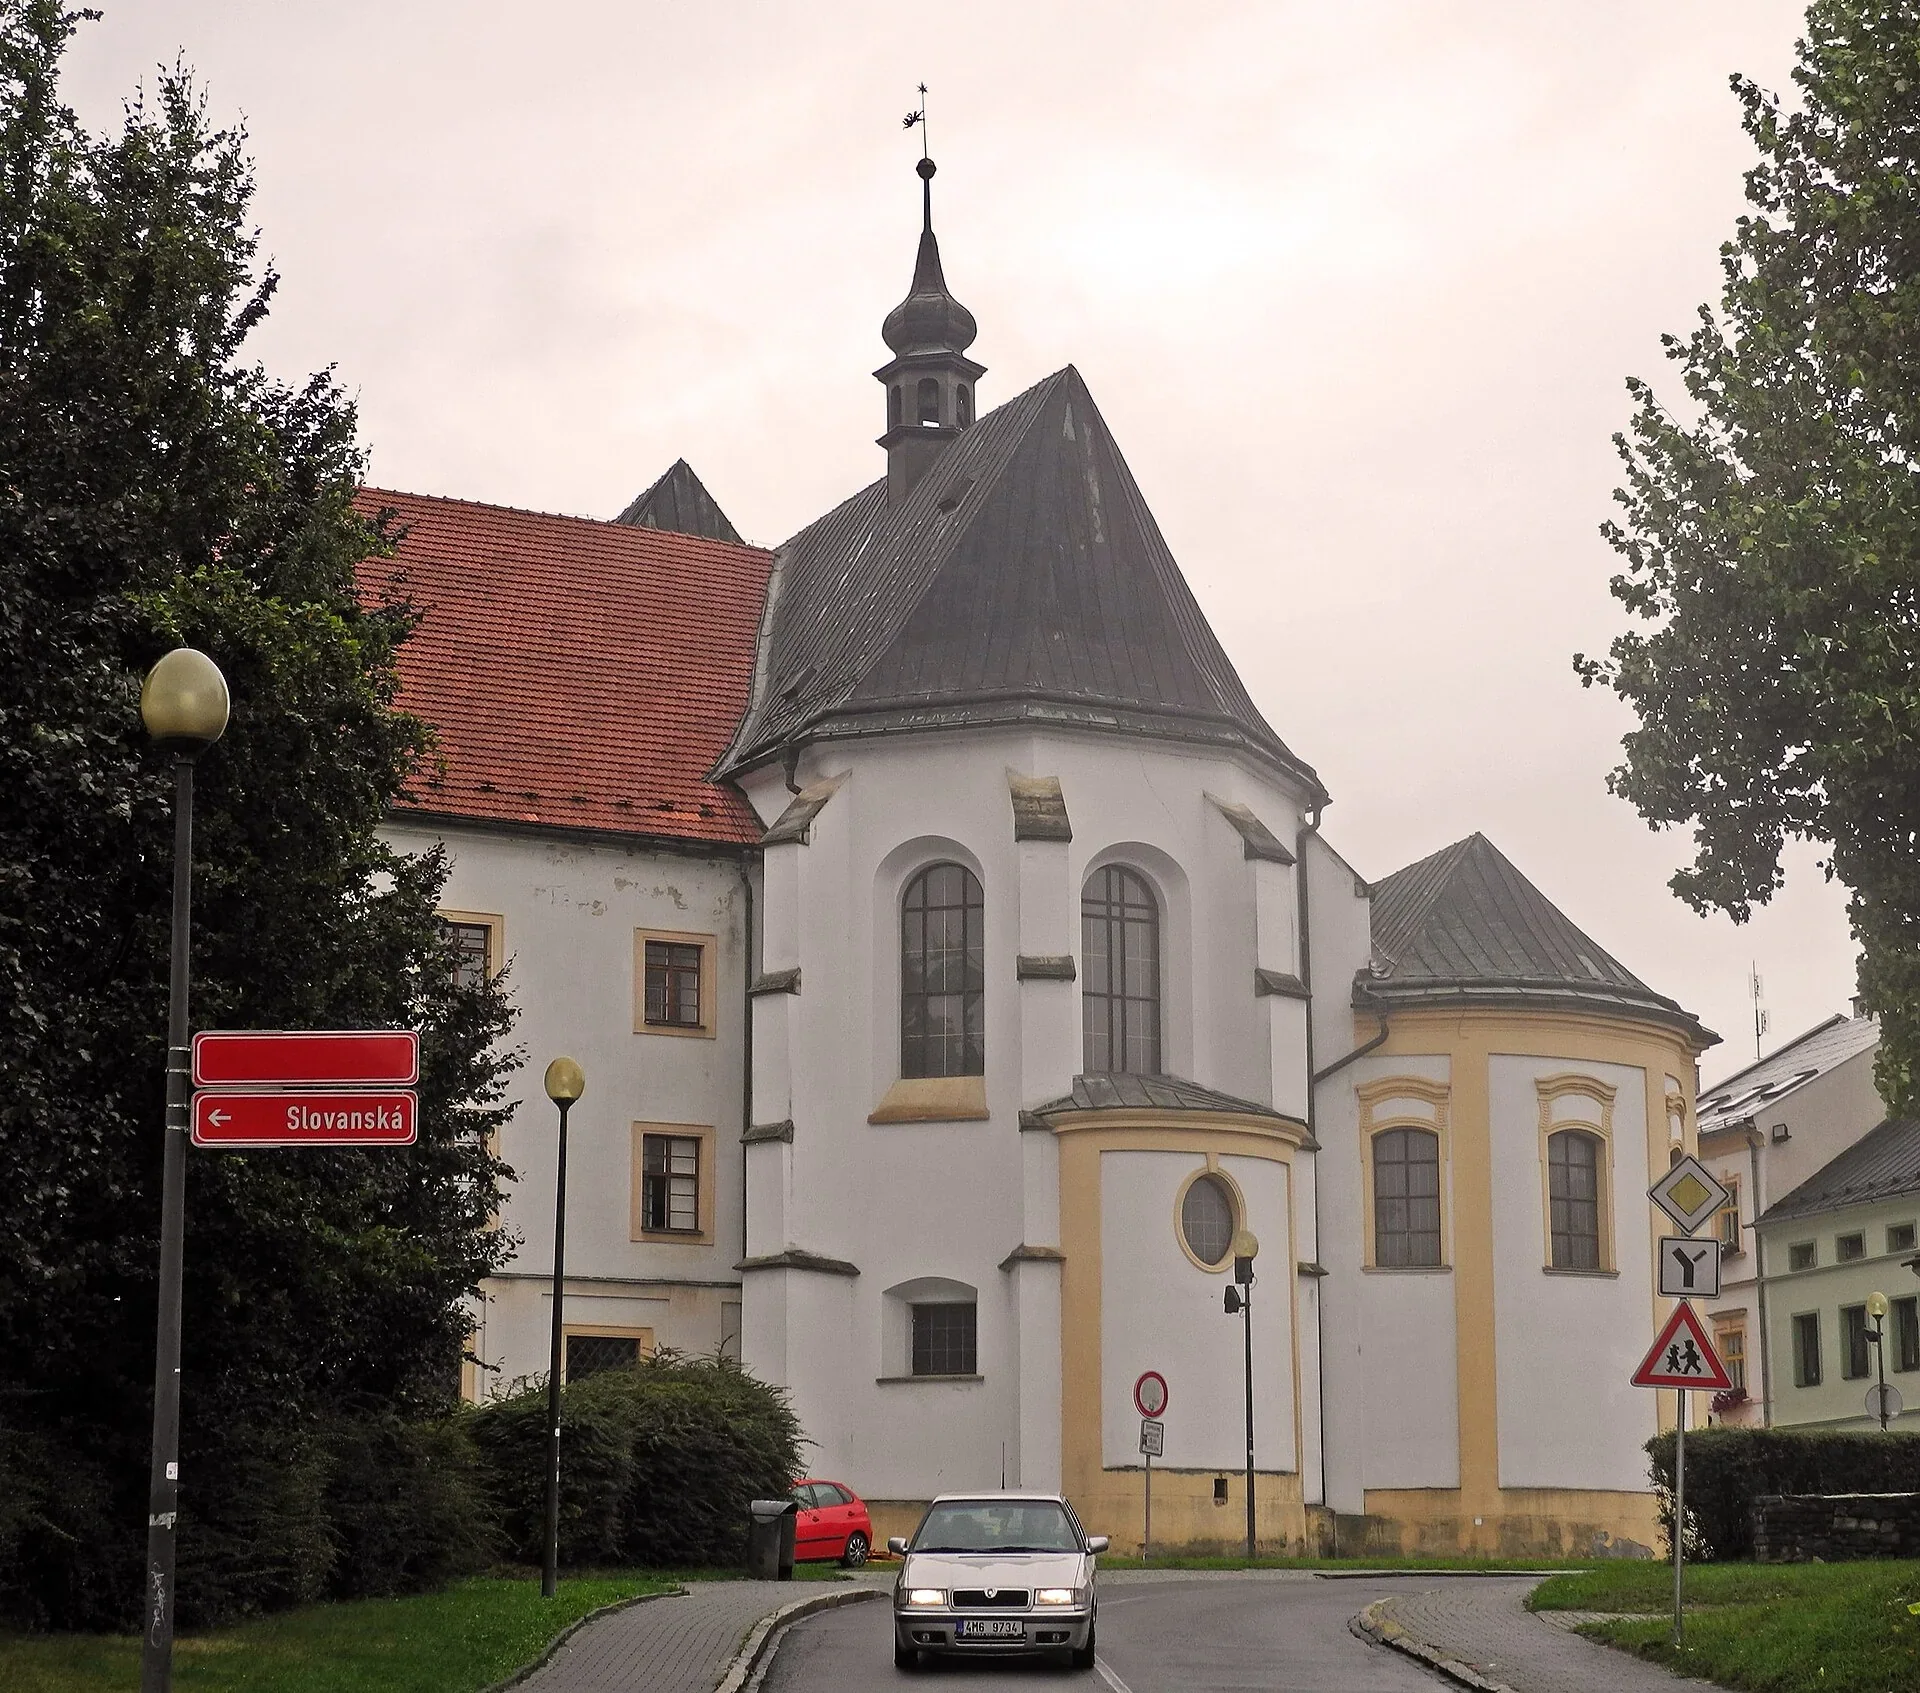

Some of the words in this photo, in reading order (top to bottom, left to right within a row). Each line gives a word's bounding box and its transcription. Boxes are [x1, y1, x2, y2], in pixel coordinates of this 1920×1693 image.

[287, 1105, 403, 1130] Slovanská
[966, 1622, 985, 1632] 4M6
[993, 1622, 1017, 1632] 9734
